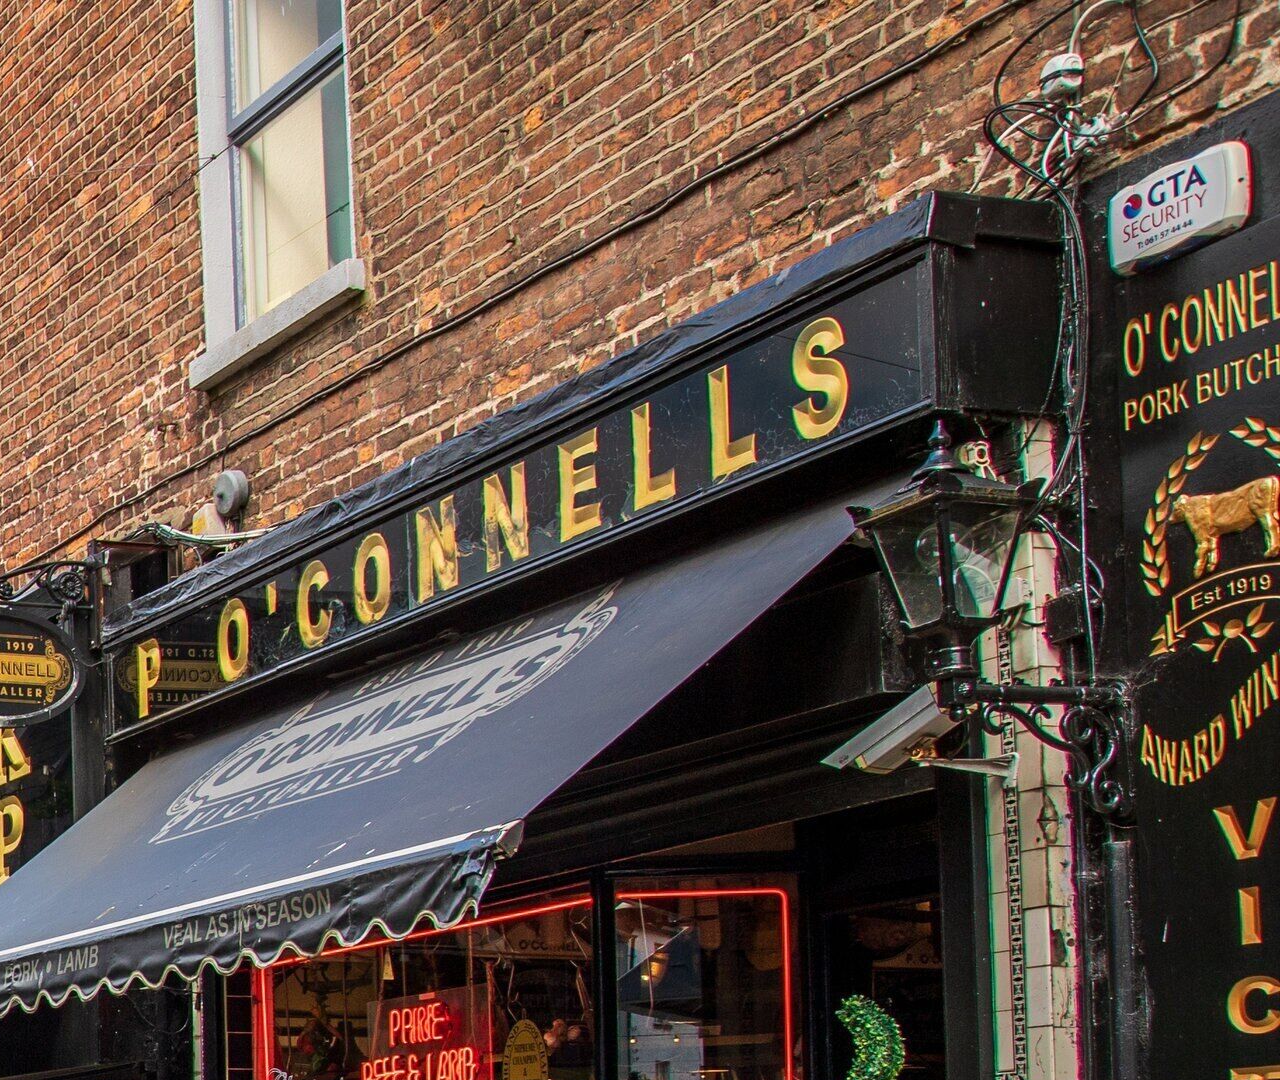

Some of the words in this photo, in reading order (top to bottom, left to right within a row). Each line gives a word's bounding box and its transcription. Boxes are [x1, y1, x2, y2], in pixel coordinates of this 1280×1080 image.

[1147, 164, 1208, 208] GTA
[1122, 188, 1208, 244] SECURITY
[1160, 230, 1169, 240] 57
[1124, 379, 1190, 431] PORK
[137, 638, 162, 719] P
[217, 317, 848, 682] O'CONNELLS
[1190, 582, 1221, 610] Est
[1226, 574, 1271, 595] 1919
[6, 641, 34, 652] 1919
[454, 617, 535, 662] 1919
[1141, 713, 1225, 787] AWARD
[189, 745, 419, 828] VICTUALLER
[56, 947, 99, 975] LAMB
[163, 917, 203, 950] VEAL
[205, 912, 227, 939] AS
[252, 888, 331, 932] SEASON
[512, 1055, 537, 1065] CHAMPION
